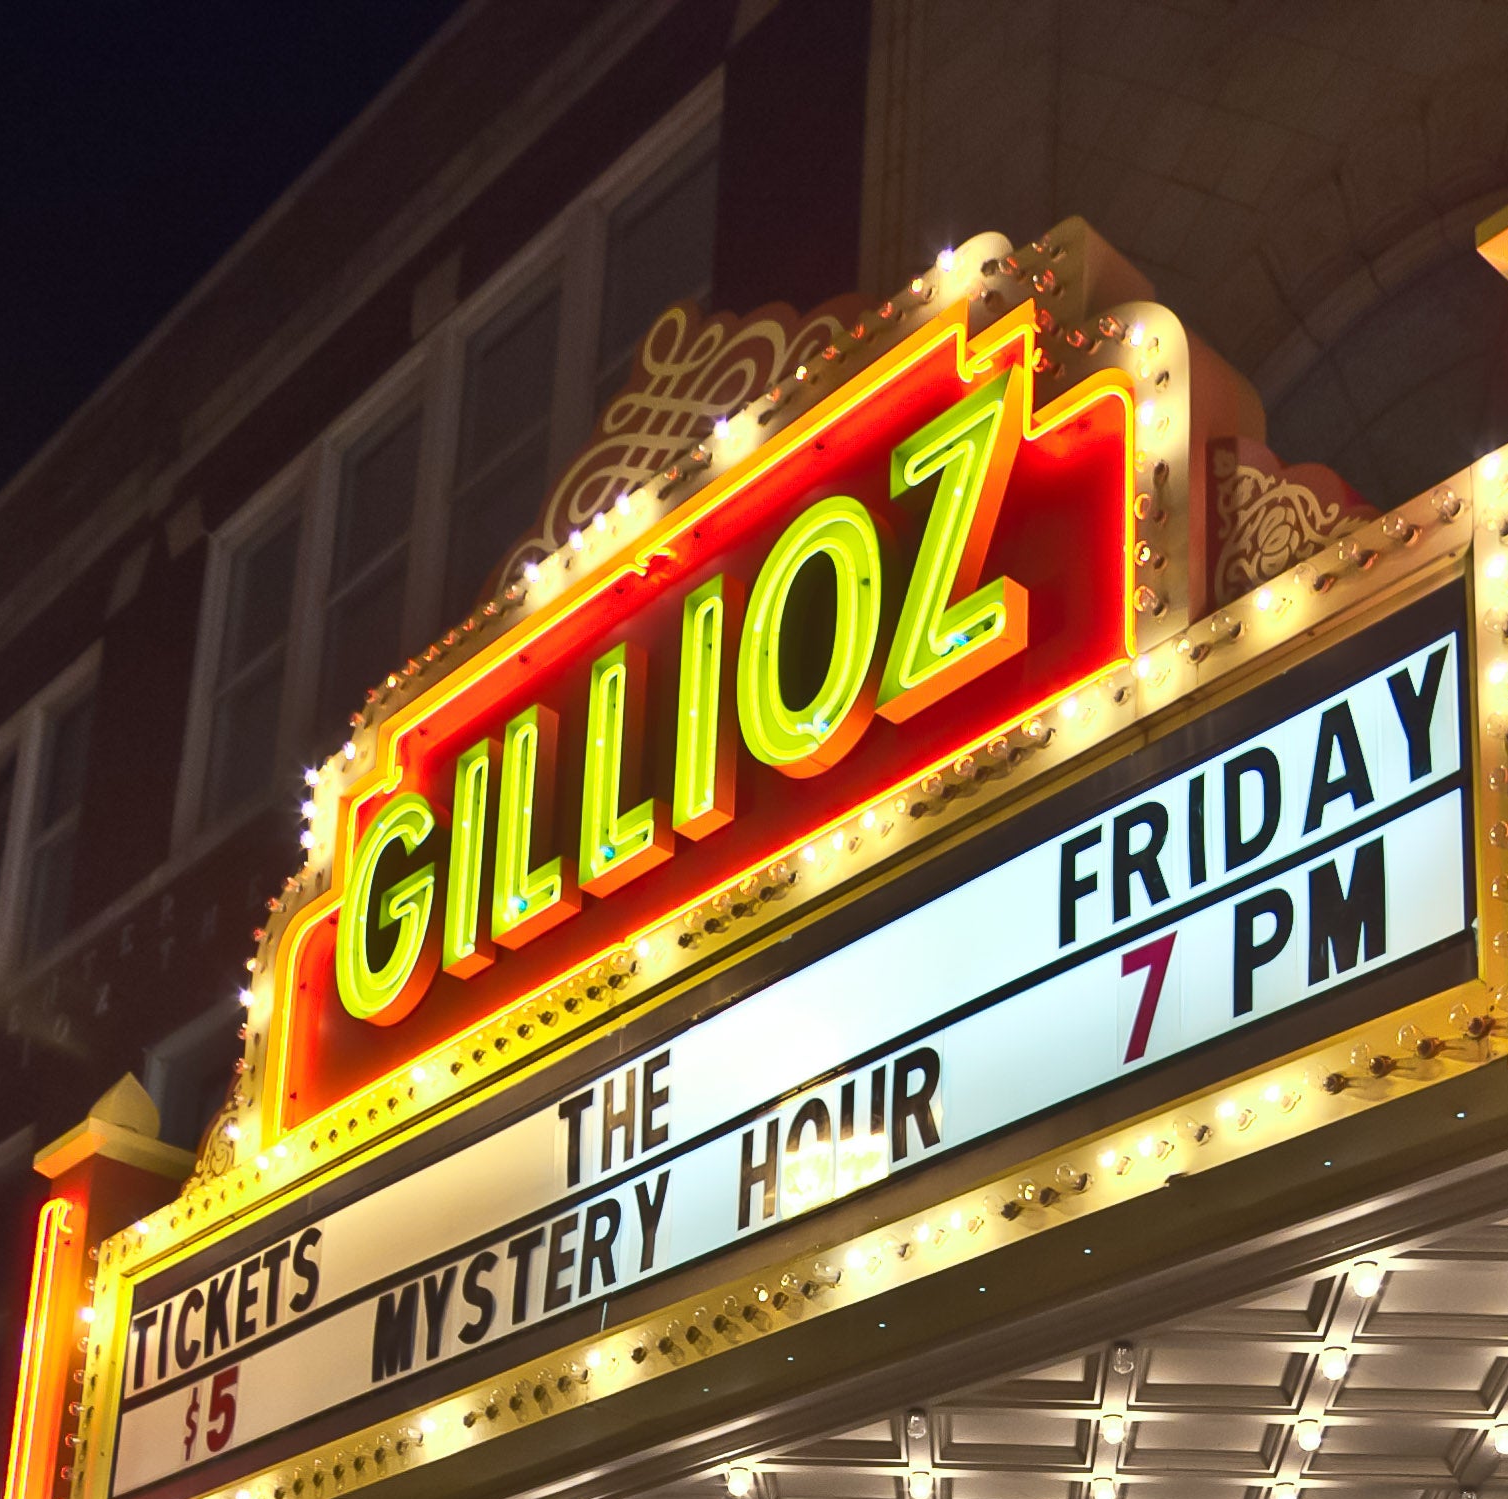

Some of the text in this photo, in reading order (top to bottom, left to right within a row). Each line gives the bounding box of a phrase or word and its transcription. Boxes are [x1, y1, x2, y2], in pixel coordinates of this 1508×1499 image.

[335, 366, 1028, 1026] GILLIOZ
[1058, 643, 1450, 949] FRIDAY
[1121, 835, 1387, 1064] 7 PM
[371, 1047, 941, 1383] MYSTERY HOUR
[558, 1049, 671, 1188] THE
[132, 1226, 323, 1391] TICKETS
[184, 1367, 240, 1461] $5
